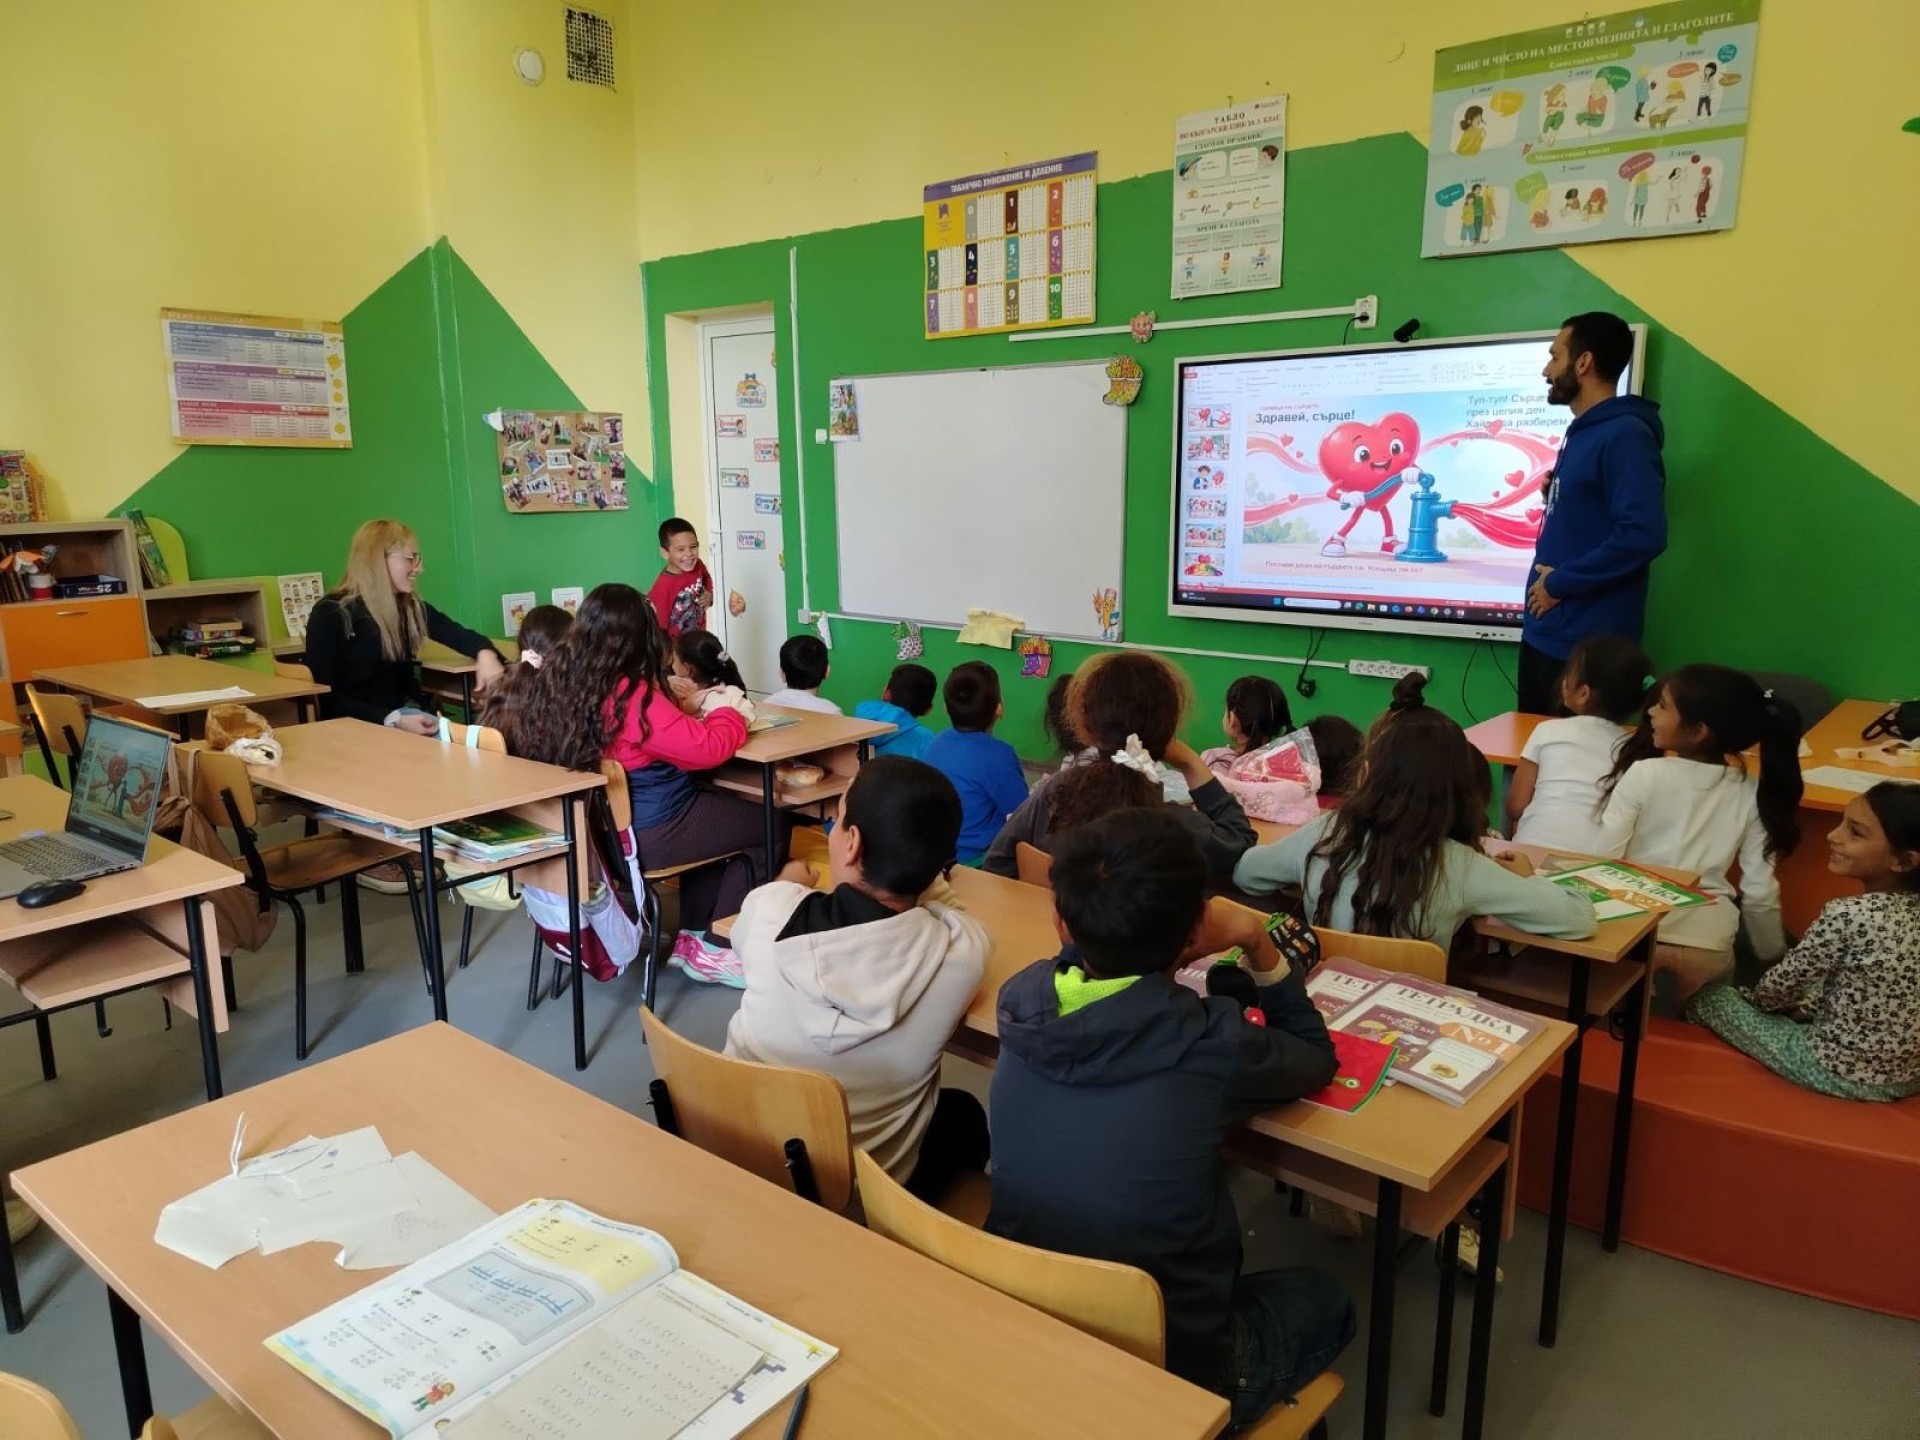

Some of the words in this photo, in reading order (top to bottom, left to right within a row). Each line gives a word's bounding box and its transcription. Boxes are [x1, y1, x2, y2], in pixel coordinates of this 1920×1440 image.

[1492, 50, 1528, 66] ЧИСЛО
[1530, 47, 1545, 59] НА
[1547, 26, 1650, 54] МЕСТОИМЕНИЯТА
[1663, 11, 1735, 33] ГЛАГОЛИТЕ
[1214, 112, 1246, 124] ТАБЛО
[950, 179, 983, 193] ТАБЛИЧНО
[983, 172, 1024, 186] УМНОЖЕНИЕ
[1031, 163, 1063, 179] ДЕЛЕНИЕ
[1009, 198, 1014, 208] 1
[1052, 189, 1059, 199] 2
[930, 257, 936, 268] 3
[968, 250, 975, 262] 4
[1009, 244, 1015, 255] 5
[1052, 235, 1059, 247] 6
[929, 300, 935, 310] 7
[968, 293, 974, 304] 8
[1009, 289, 1015, 300] 9
[1050, 283, 1061, 293] 10
[1255, 412, 1309, 424] Здравей,
[1312, 410, 1355, 423] сърце!
[1516, 418, 1567, 428] разберем
[1397, 988, 1514, 1035] ТЕТРАДКА
